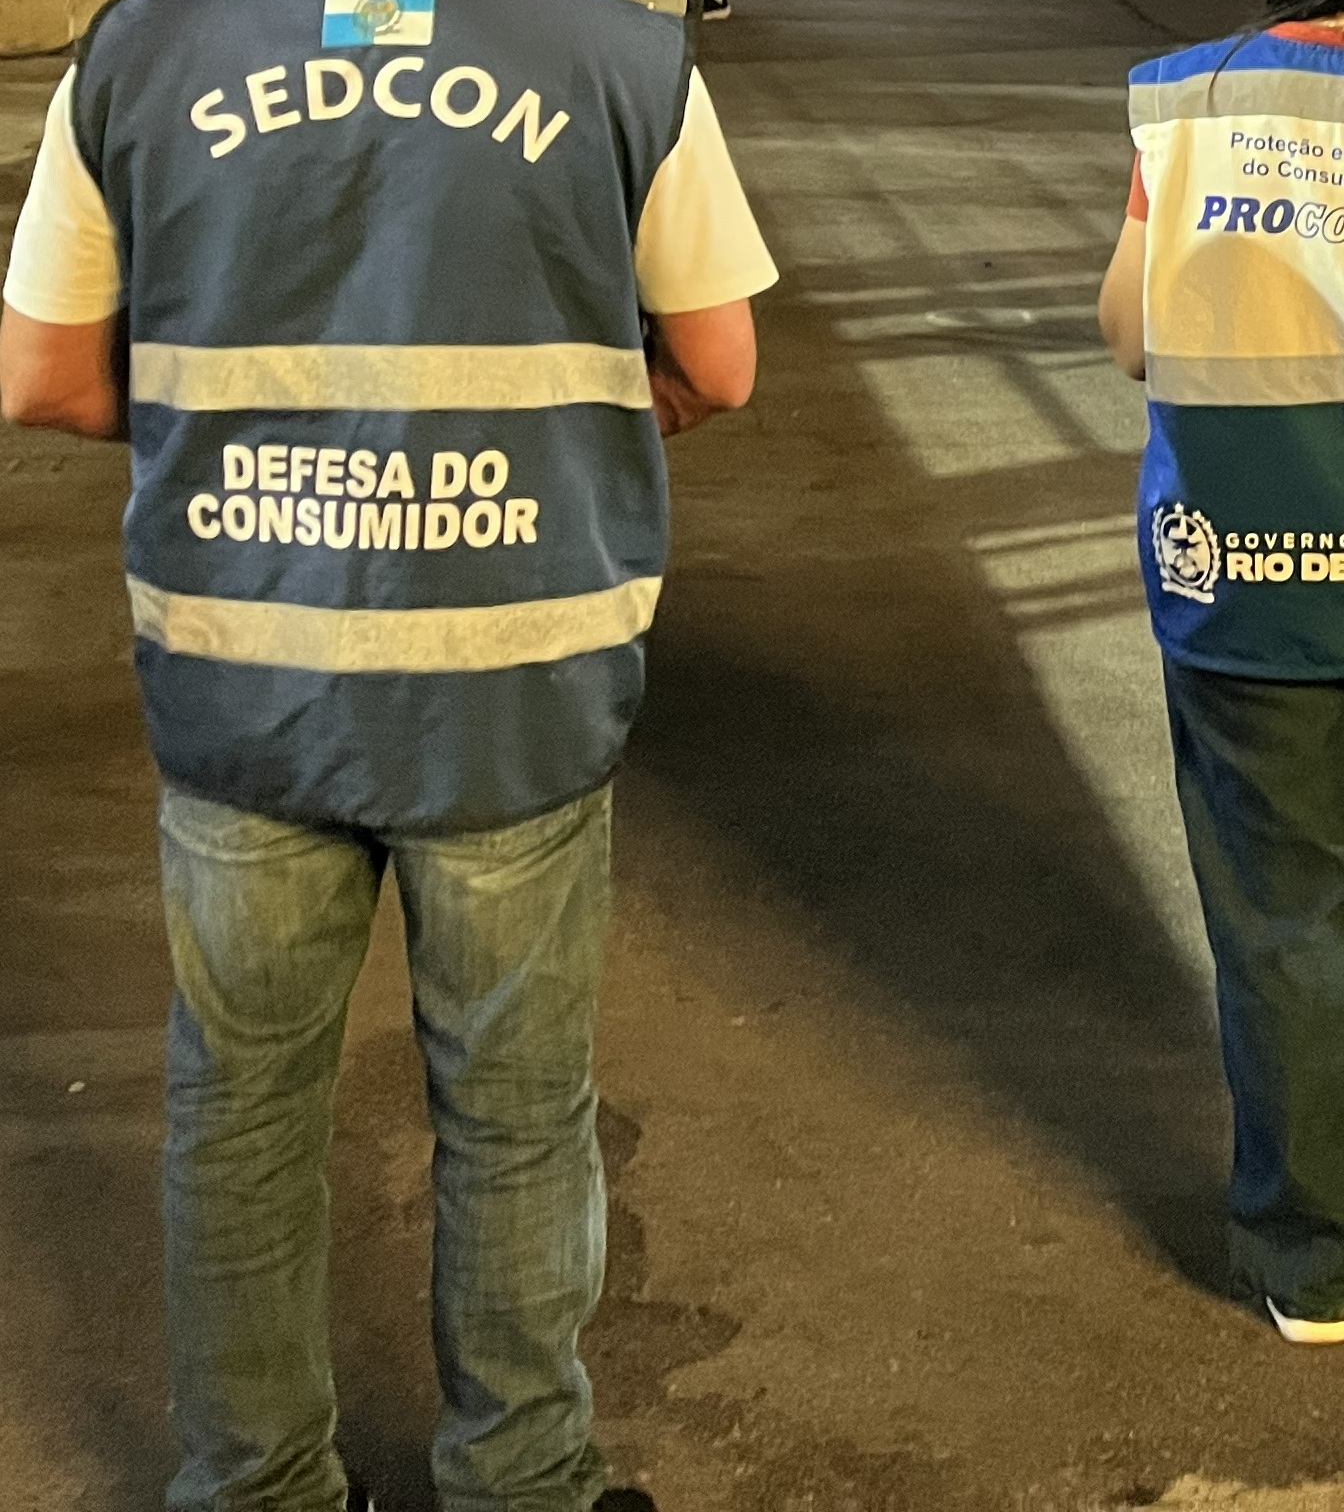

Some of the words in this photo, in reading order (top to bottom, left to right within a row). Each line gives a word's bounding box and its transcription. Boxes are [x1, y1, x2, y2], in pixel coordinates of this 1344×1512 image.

[190, 56, 570, 164] SEDCON
[1229, 131, 1325, 160] Proteção
[1331, 146, 1343, 161] e
[1242, 158, 1270, 177] do
[222, 444, 415, 500] DEFESA
[430, 449, 510, 499] DO
[187, 493, 540, 551] CONSUMIDOR
[1226, 552, 1295, 582] RIO
